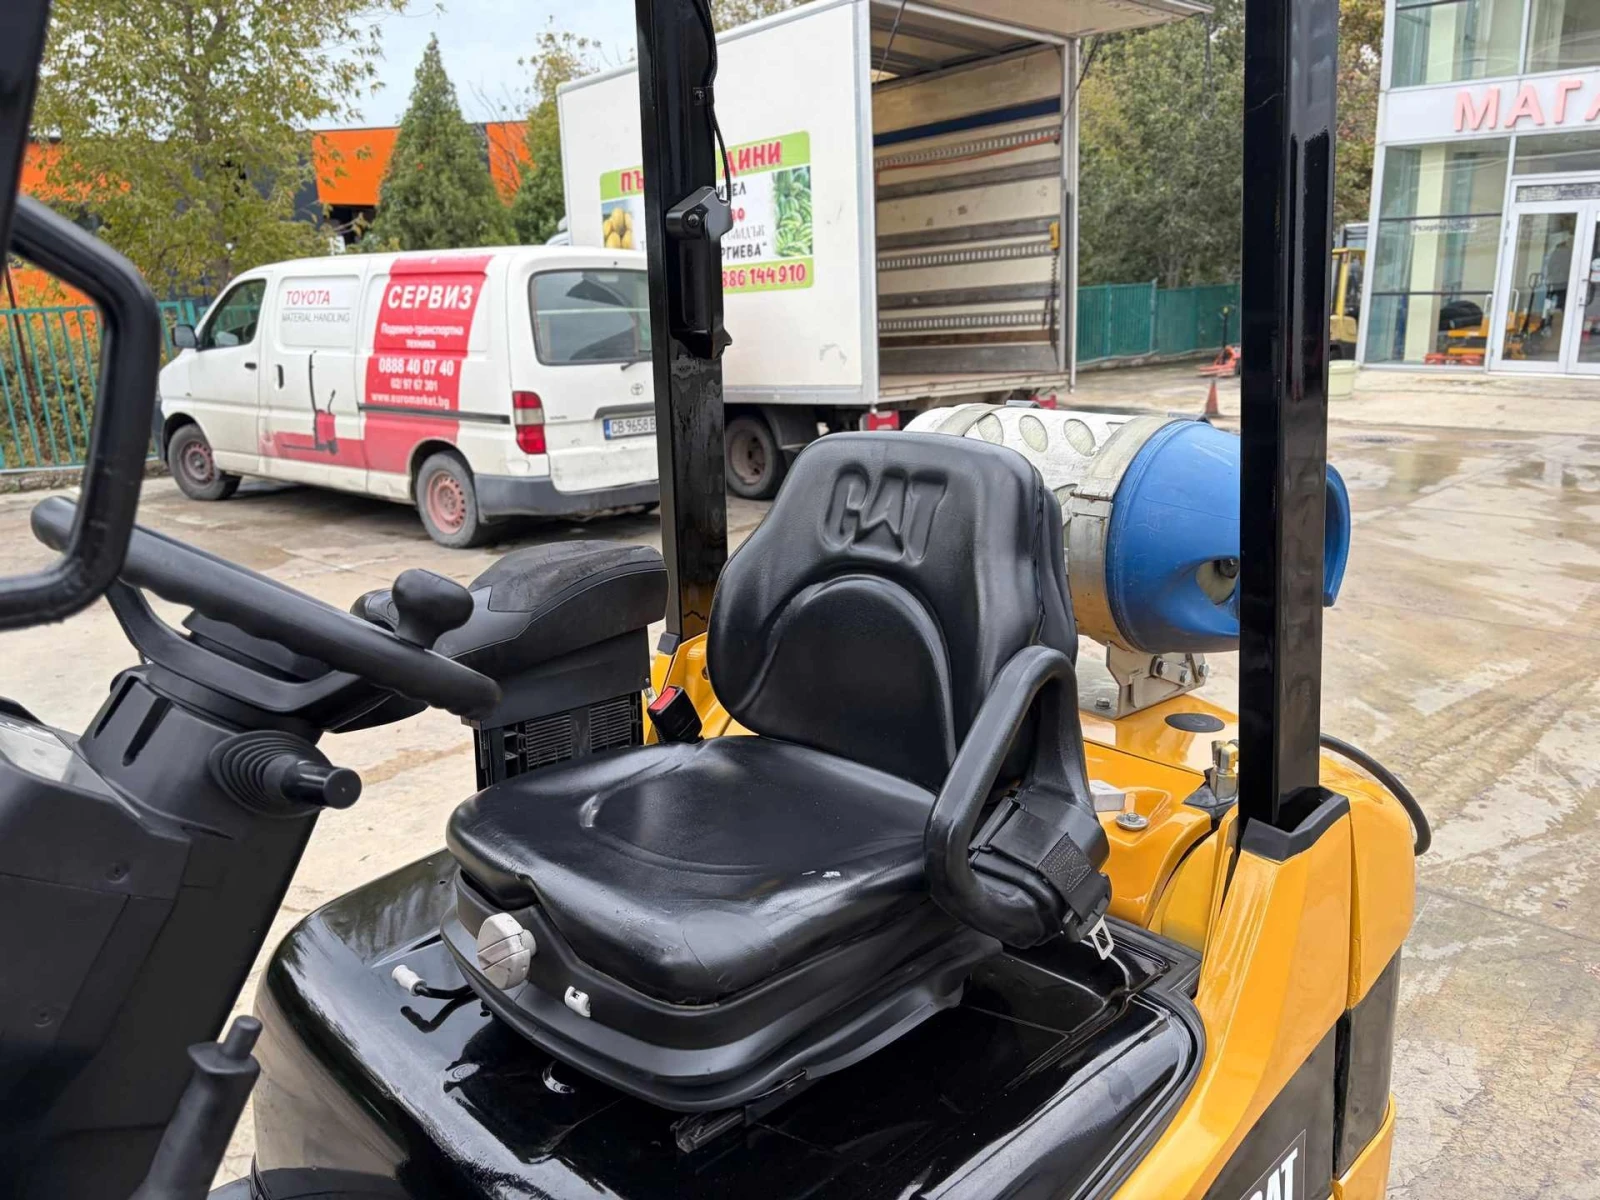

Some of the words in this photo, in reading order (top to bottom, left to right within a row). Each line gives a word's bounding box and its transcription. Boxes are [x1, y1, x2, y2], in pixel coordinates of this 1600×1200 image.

[621, 170, 644, 192] ПЪ
[722, 269, 746, 287] 886
[749, 267, 776, 285] 144
[778, 263, 806, 283] 910
[285, 290, 331, 306] TOYOTA
[387, 285, 473, 310] СЕРВИЗ
[282, 312, 313, 323] MATERIAL
[314, 312, 350, 323] HANDLING
[378, 357, 404, 374] 0888
[406, 358, 421, 375] 40
[422, 359, 437, 376] 07
[439, 359, 455, 377] 40
[402, 378, 412, 391] 97
[371, 393, 450, 410] www.euromarket.bg
[612, 420, 625, 434] CB
[625, 418, 649, 432] 9658
[820, 463, 948, 565] CAT
